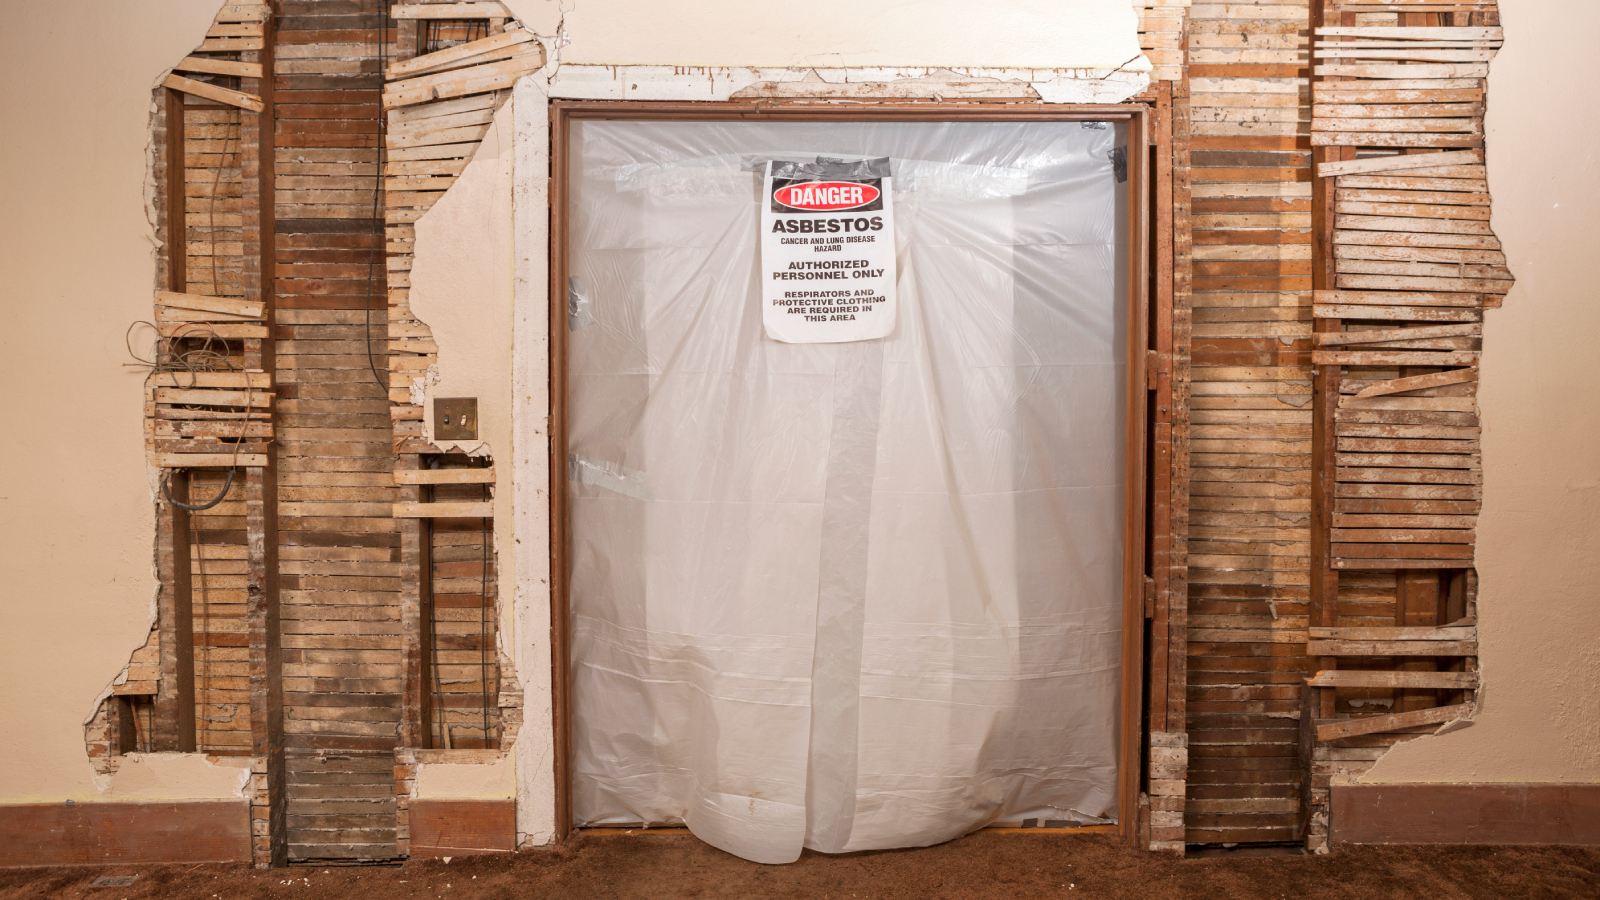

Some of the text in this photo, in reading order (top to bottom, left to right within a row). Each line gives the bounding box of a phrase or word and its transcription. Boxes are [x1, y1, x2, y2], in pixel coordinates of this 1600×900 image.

[790, 186, 864, 206] DANGER
[771, 216, 884, 234] ASBESTOS
[780, 237, 809, 245] CANCER
[826, 236, 845, 244] LUNG
[846, 235, 875, 243] DISEASE
[814, 244, 842, 253] HAZARD
[788, 259, 869, 270] AUTHORIZED
[773, 268, 885, 281] PERSONNEL ONLY
[784, 289, 875, 298] RESPIRATORS AND
[836, 295, 886, 305] CLOTHING
[809, 306, 860, 314] REQUIRED
